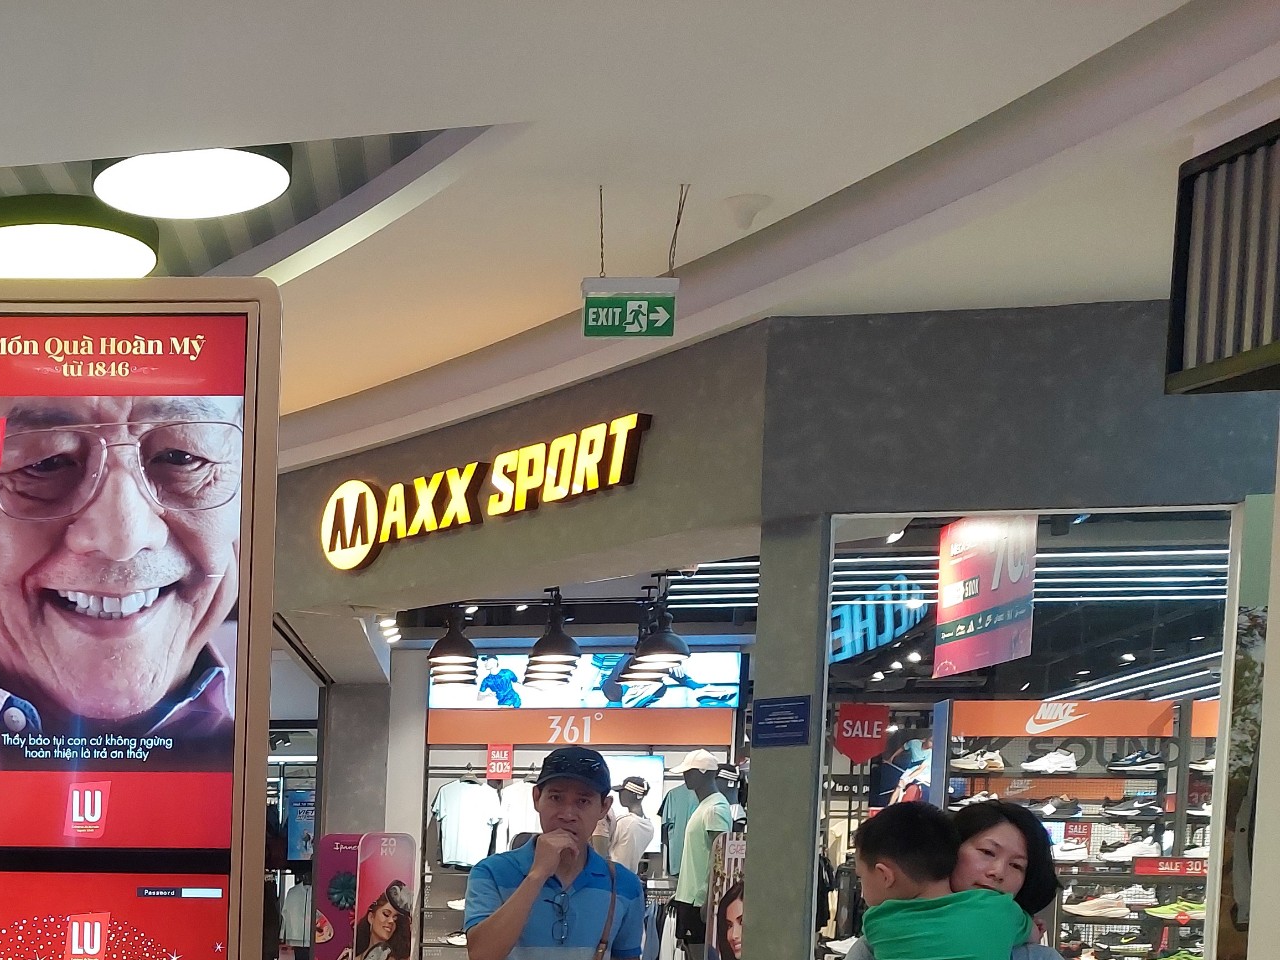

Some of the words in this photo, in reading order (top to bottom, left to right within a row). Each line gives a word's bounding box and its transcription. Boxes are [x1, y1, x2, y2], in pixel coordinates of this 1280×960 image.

[588, 308, 622, 326] EXIT
[44, 335, 94, 362] Quà
[99, 335, 163, 355] Hoàn
[169, 335, 206, 361] Mỹ
[62, 360, 83, 377] từ
[87, 361, 130, 377] 1846
[322, 463, 479, 569] MAXX
[487, 413, 640, 516] SPORT
[1035, 702, 1079, 720] NIKE
[842, 720, 883, 738] SALE
[1, 733, 26, 748] Thầy
[29, 733, 51, 746] bảo
[67, 737, 87, 746] con
[89, 736, 103, 746] cứ
[105, 733, 137, 749] không
[140, 735, 173, 749] ngừng
[25, 748, 51, 758] hoàn
[53, 748, 78, 761] thiện
[81, 748, 91, 758] là
[94, 748, 108, 758] trả
[126, 747, 150, 761] thầy
[491, 750, 509, 760] SALE
[489, 761, 511, 773] 30%
[72, 790, 102, 822] LU
[1069, 825, 1088, 834] SALE
[333, 842, 359, 853] Ipane
[729, 844, 746, 855] GRE
[1158, 861, 1181, 872] SALE
[72, 921, 101, 955] LU
